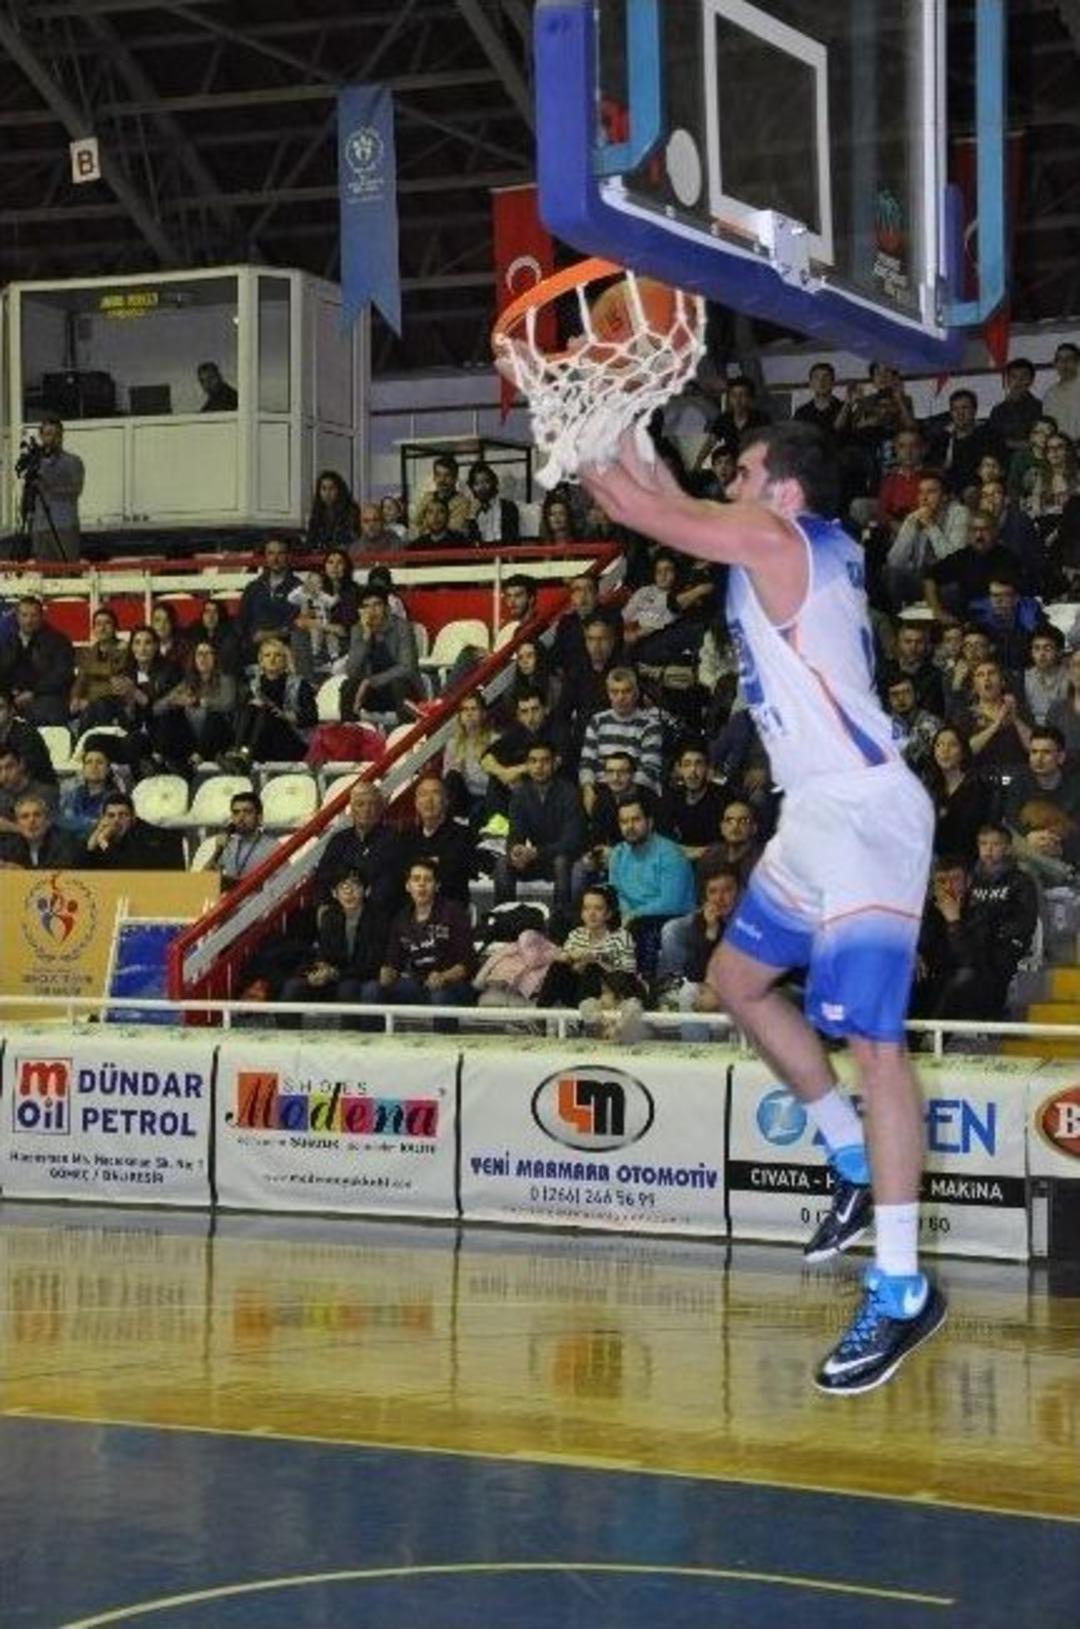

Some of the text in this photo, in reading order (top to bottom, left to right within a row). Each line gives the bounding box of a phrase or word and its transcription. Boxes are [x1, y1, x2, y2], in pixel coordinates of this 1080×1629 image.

[77, 150, 94, 176] B
[79, 1063, 203, 1098] DÜNDAR
[225, 1073, 438, 1137] Modena
[82, 1108, 196, 1136] PETROL
[515, 1160, 610, 1183] MARMARA
[616, 1162, 718, 1189] OTOMOTİV
[750, 1168, 811, 1189] CIVATA
